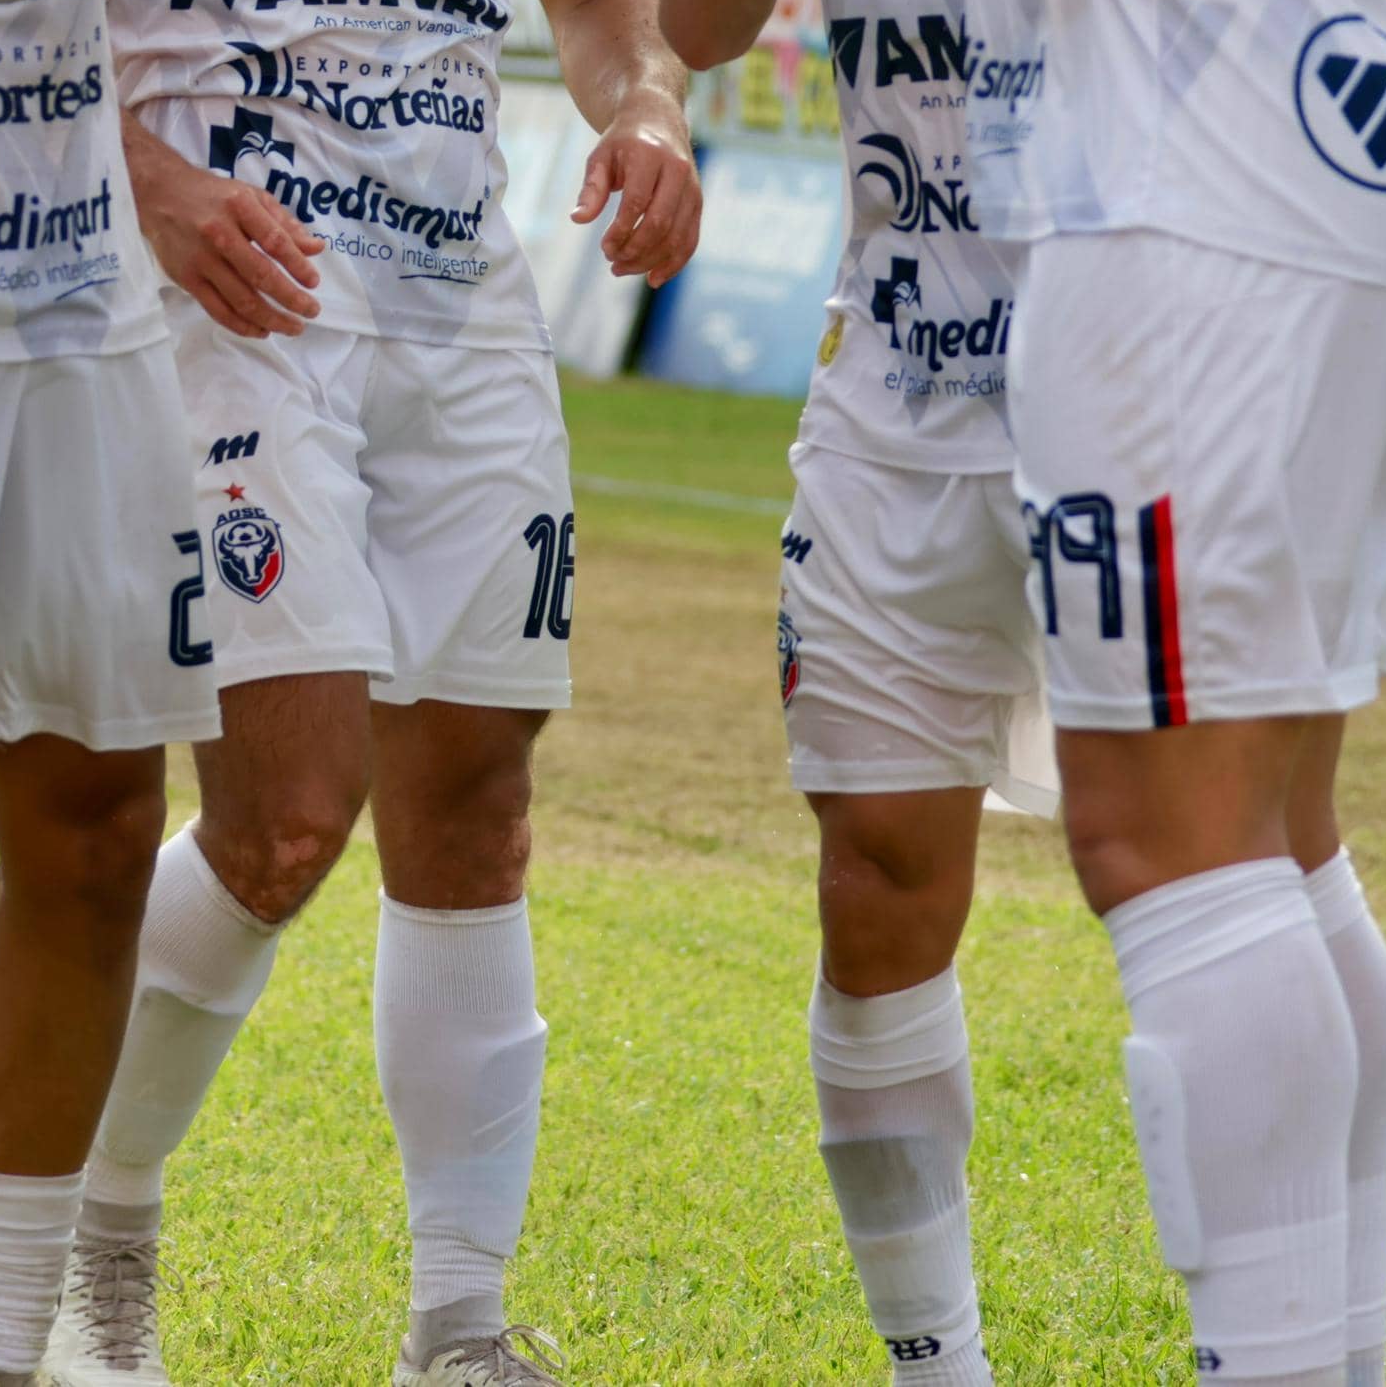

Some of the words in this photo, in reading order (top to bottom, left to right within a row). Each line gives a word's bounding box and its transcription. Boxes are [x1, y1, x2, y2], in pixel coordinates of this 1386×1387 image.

[293, 78, 485, 134] Norteñas
[265, 168, 485, 249] medismart
[401, 244, 489, 277] inteligente
